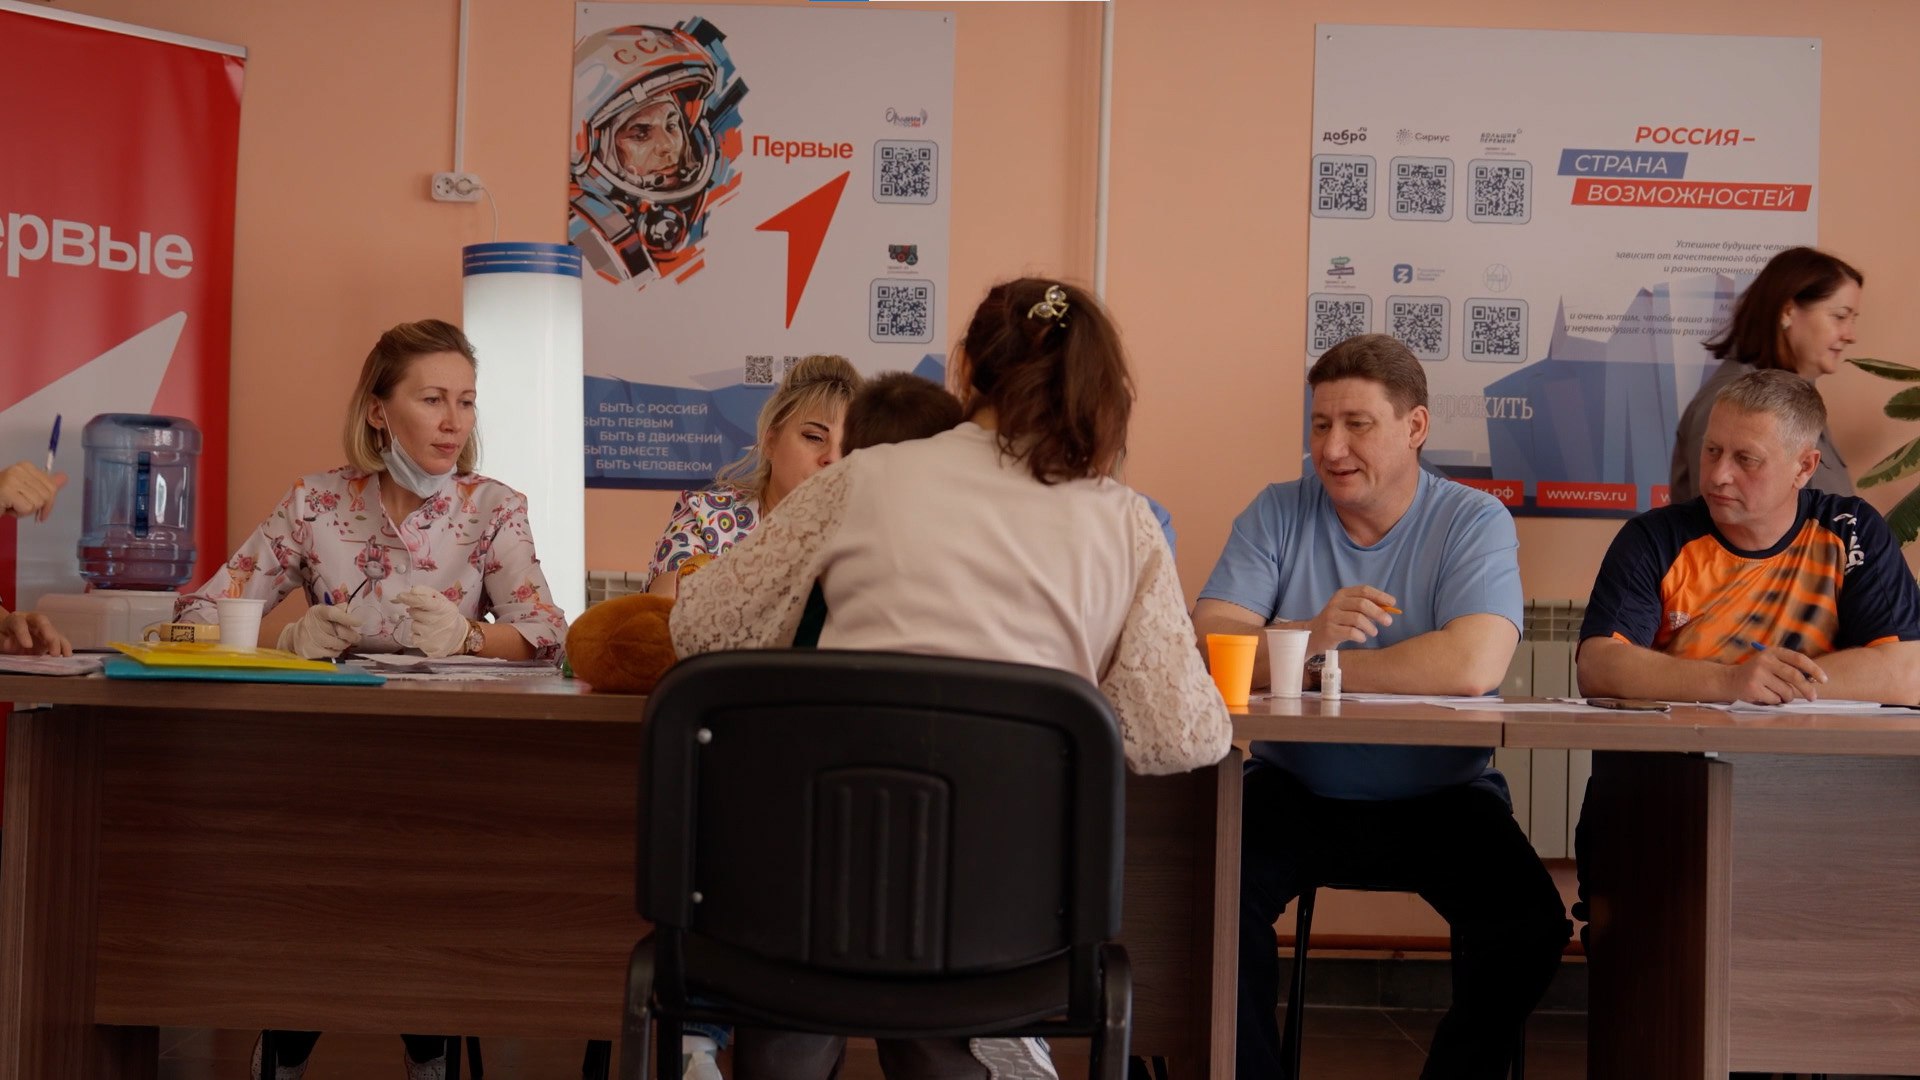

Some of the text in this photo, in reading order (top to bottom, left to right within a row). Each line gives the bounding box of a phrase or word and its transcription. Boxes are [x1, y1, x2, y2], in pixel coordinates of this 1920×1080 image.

[1323, 129, 1367, 145] добро
[1415, 133, 1450, 142] Сириус
[752, 135, 853, 164] Первые
[1575, 154, 1668, 174] СТРАНА
[1587, 184, 1794, 207] ВОЗМОЖНОСТЕЙ
[0, 212, 193, 279] рвые
[1676, 240, 1720, 249] Успешное
[1722, 241, 1761, 252] будущее
[1673, 253, 1743, 262] качественного
[1745, 254, 1772, 264] обра
[1643, 314, 1675, 322] чтобы
[1642, 327, 1681, 336] служили
[600, 403, 708, 415] БЫТЬ С РОССИЕЙ
[619, 418, 673, 428] ПЕРВЫМ
[600, 431, 722, 443] БЫТЬ В ДВИЖЕНИИ
[584, 445, 669, 456] БЫТЬ ВМЕСТЕ
[596, 459, 712, 471] БЫТЬ ЧЕЛОВЕКОМ
[1546, 489, 1627, 501] www.rsv.ru
